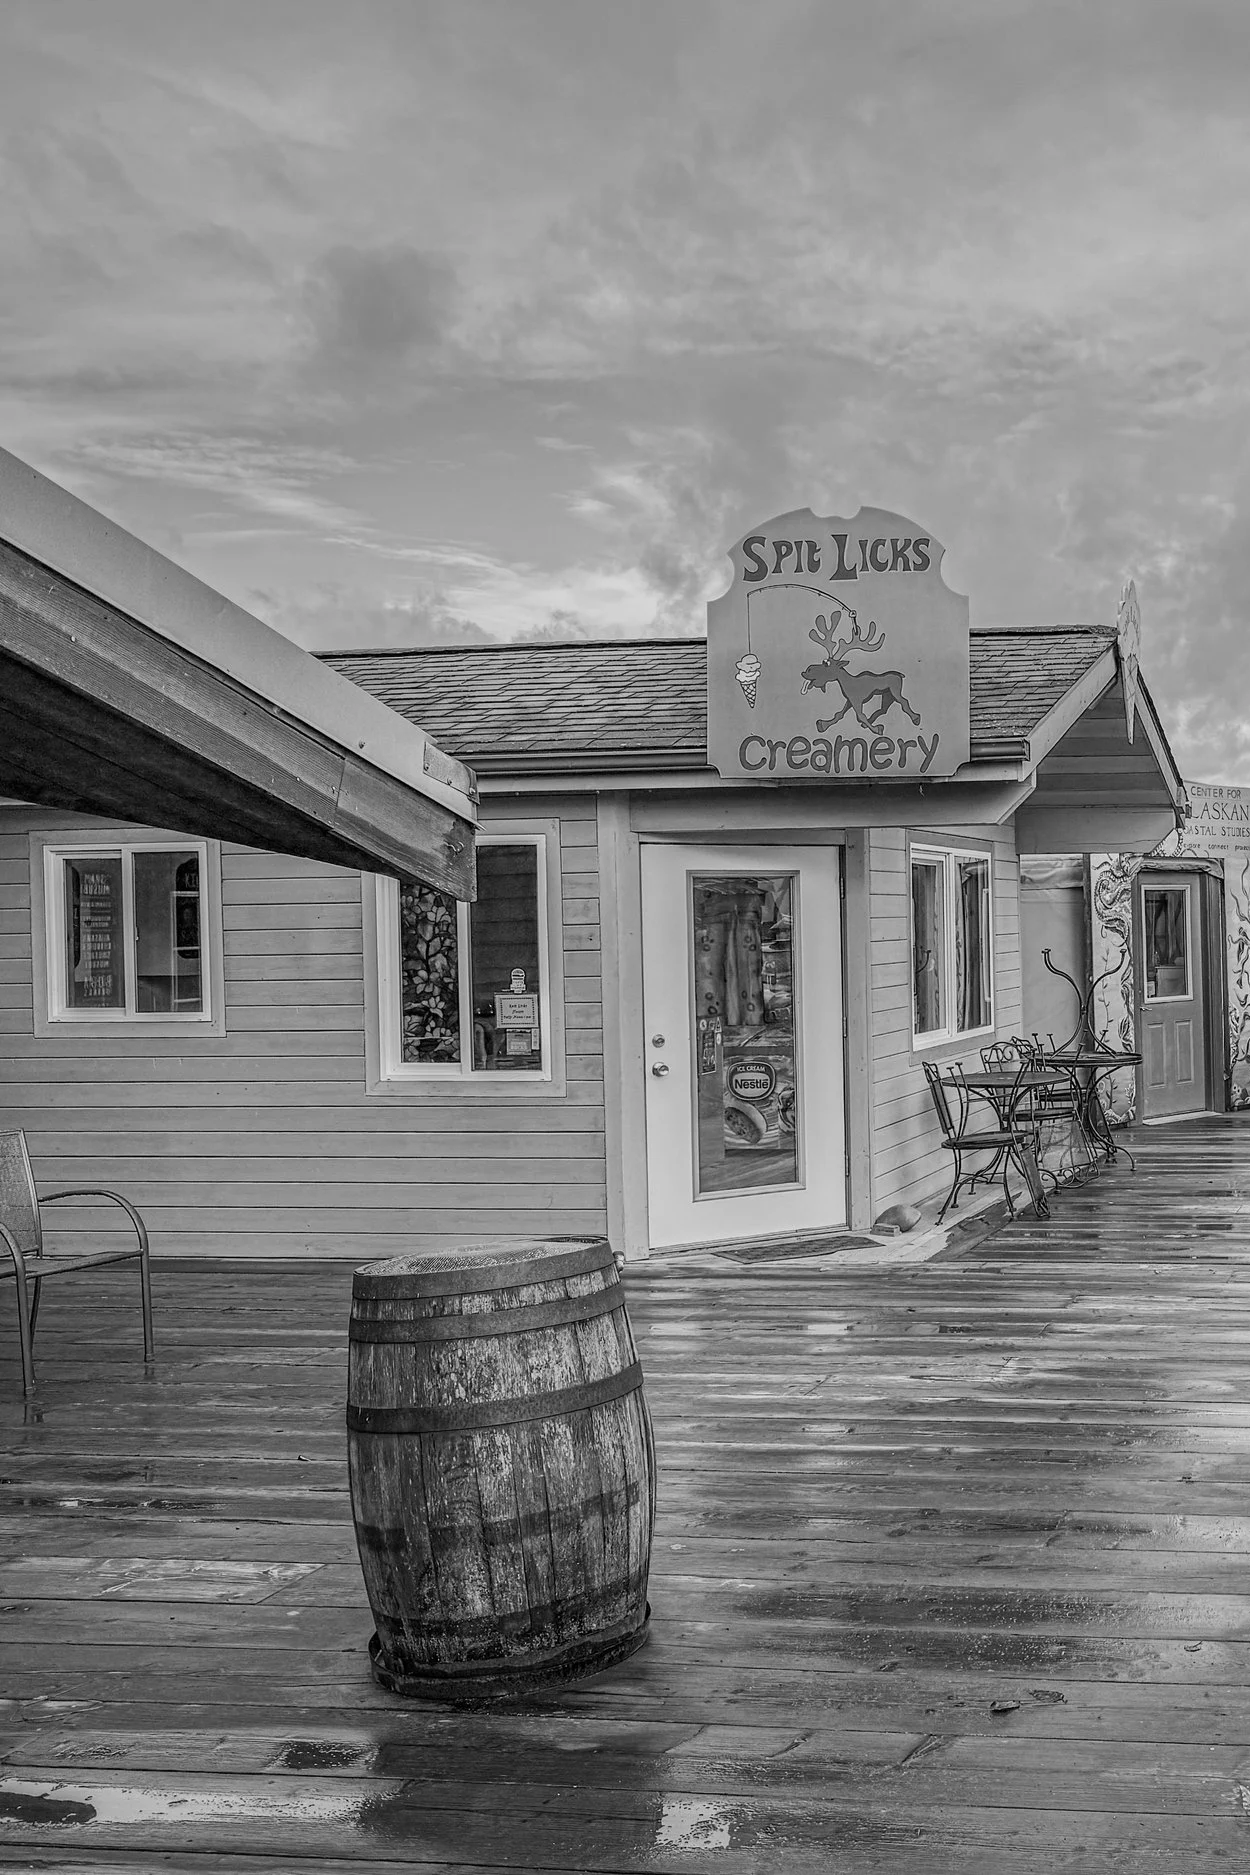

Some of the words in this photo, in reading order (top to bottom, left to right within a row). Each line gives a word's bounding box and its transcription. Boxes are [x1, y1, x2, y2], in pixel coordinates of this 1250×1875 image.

[829, 533, 931, 581] LICKS
[1190, 786, 1224, 798] CENTER
[1227, 789, 1241, 799] FOR
[1190, 801, 1249, 820] LASKAN
[1221, 826, 1250, 837] STUDIES
